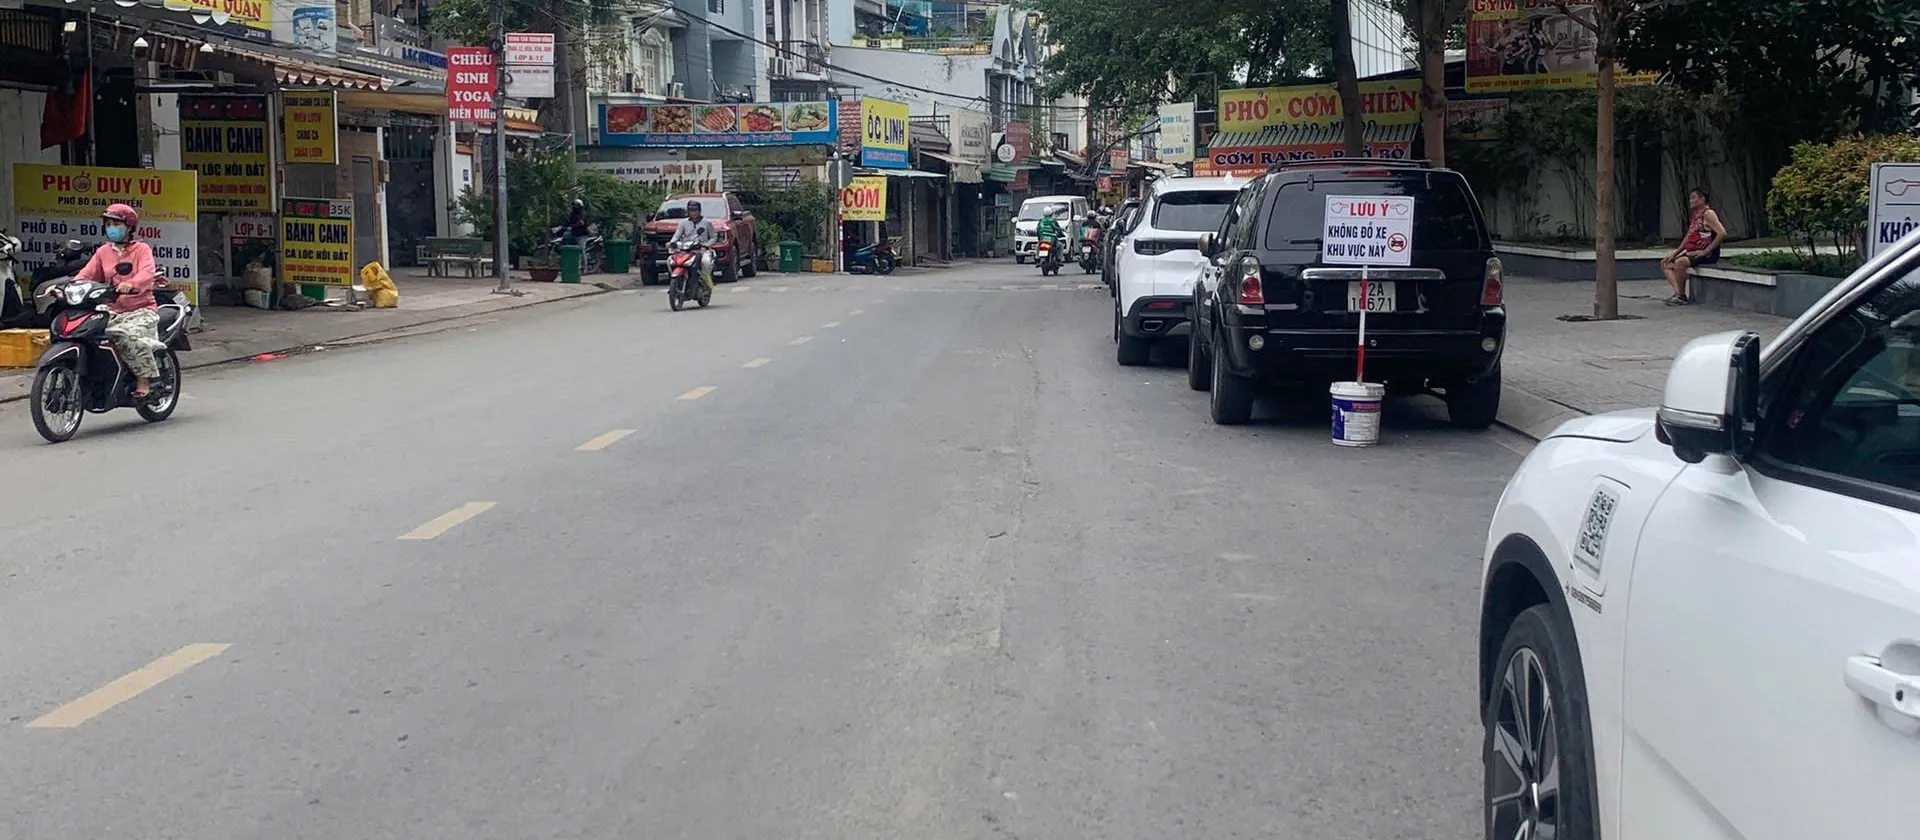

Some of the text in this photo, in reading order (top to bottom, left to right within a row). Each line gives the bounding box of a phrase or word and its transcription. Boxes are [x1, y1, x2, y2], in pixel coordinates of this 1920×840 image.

[1473, 0, 1517, 12] GYM
[456, 72, 488, 84] SINH
[453, 91, 492, 102] YOGA
[1223, 90, 1268, 121] PHỞ
[1287, 92, 1336, 118] CƠM
[1360, 88, 1417, 114] HIÊN
[867, 104, 905, 146] ỐC LINH
[185, 123, 264, 153] BÁNH CANH
[1214, 151, 1254, 165] CƠM
[1260, 151, 1315, 163] RANG
[1332, 145, 1372, 159] PỞ
[42, 171, 163, 195] PHỞ DUY VŨ
[92, 196, 107, 206] GIA
[844, 185, 880, 209] CƠM
[331, 204, 351, 216] 35K
[1350, 200, 1390, 216] LƯU Ý
[21, 217, 46, 233] PHỞ
[50, 218, 67, 234] BÒ
[80, 220, 97, 236] BÒ
[235, 220, 254, 236] LỚP
[286, 218, 348, 244] BÁNH CANH
[1328, 221, 1387, 239] KHÔNG ĐỖ XE
[1879, 216, 1919, 243] KHÔ
[175, 243, 190, 260] BÒ
[1327, 242, 1387, 260] KHU VỰC NÀY
[174, 263, 190, 279] BÒ
